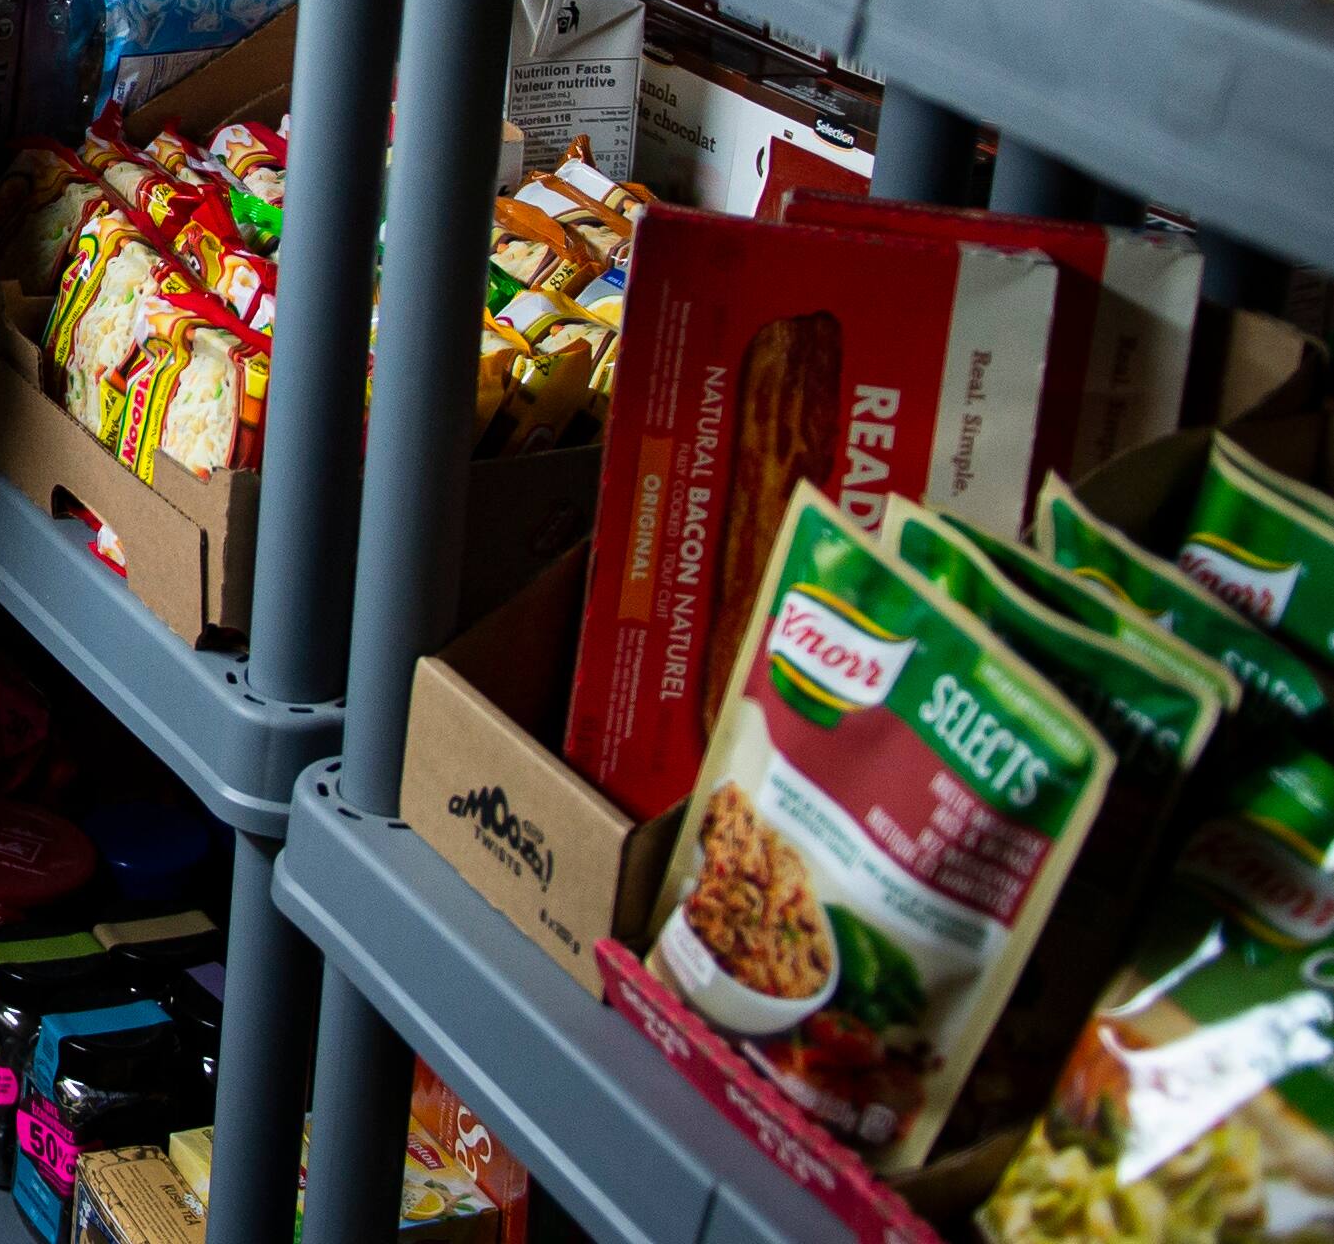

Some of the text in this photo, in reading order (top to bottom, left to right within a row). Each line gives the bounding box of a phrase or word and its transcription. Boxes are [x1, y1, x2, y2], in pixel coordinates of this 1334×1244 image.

[513, 77, 616, 94] Valeur nutritive
[514, 63, 612, 81] Nutrition Facts
[511, 113, 552, 126] Calories
[653, 109, 717, 153] chocolat
[815, 119, 855, 146] Selection
[951, 350, 992, 499] Real. Simple.
[837, 383, 902, 534] READ
[630, 474, 661, 581] ORIGINAL
[666, 478, 688, 537] COOKED
[659, 365, 728, 702] NATURAL BACON NATUREL
[662, 551, 677, 584] TOUT
[656, 588, 670, 621] CUIT
[781, 601, 887, 688] Knorr
[918, 673, 1051, 806] SELECTS
